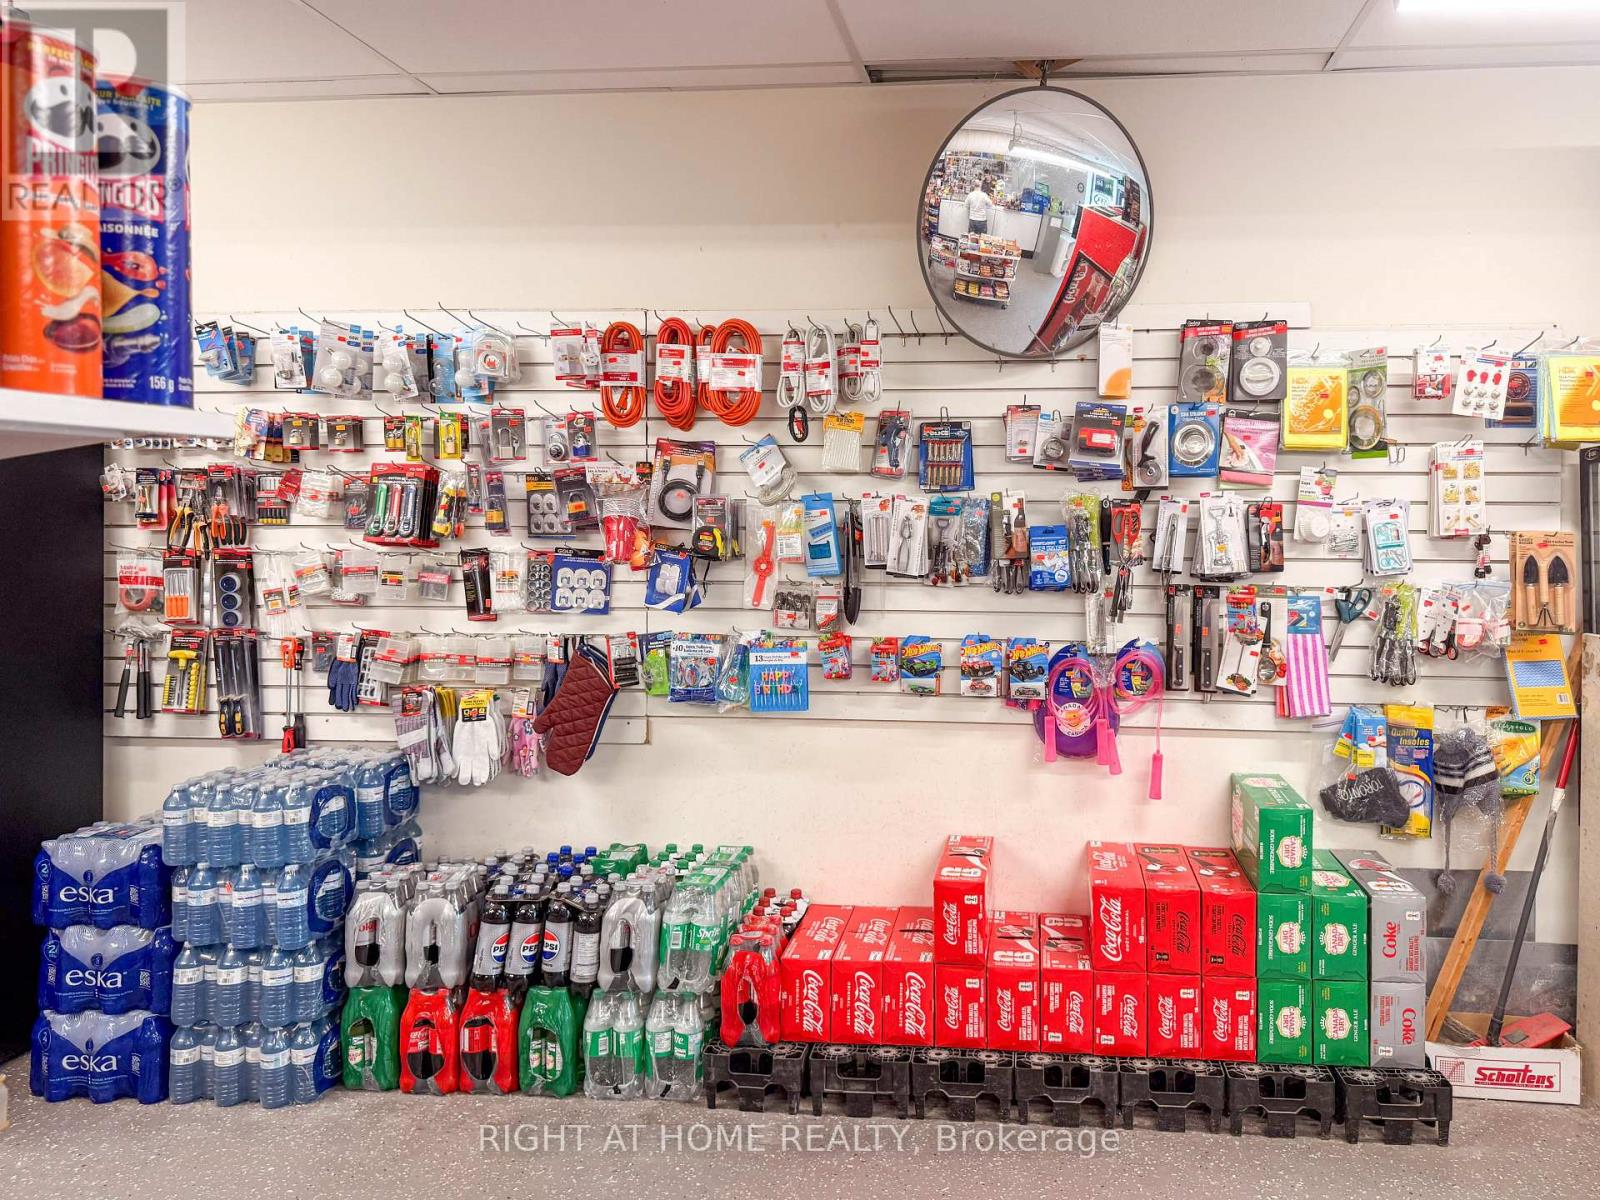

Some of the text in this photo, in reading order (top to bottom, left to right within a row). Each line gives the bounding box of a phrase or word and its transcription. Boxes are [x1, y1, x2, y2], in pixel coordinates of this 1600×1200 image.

[149, 375, 166, 389] 156
[1391, 727, 1419, 738] Quality
[1400, 737, 1430, 746] Insoles
[59, 886, 114, 904] eska
[1099, 893, 1123, 962] Coca-Cola
[1382, 921, 1397, 958] Coke
[65, 969, 123, 988] eska
[803, 969, 824, 1036] Coca-Cola
[854, 971, 875, 1038] Coca-Cola
[904, 971, 926, 1039] Coca-Cola
[1402, 1007, 1416, 1045] Coke
[62, 1054, 118, 1072] eska
[1474, 1064, 1555, 1089] Scholtens
